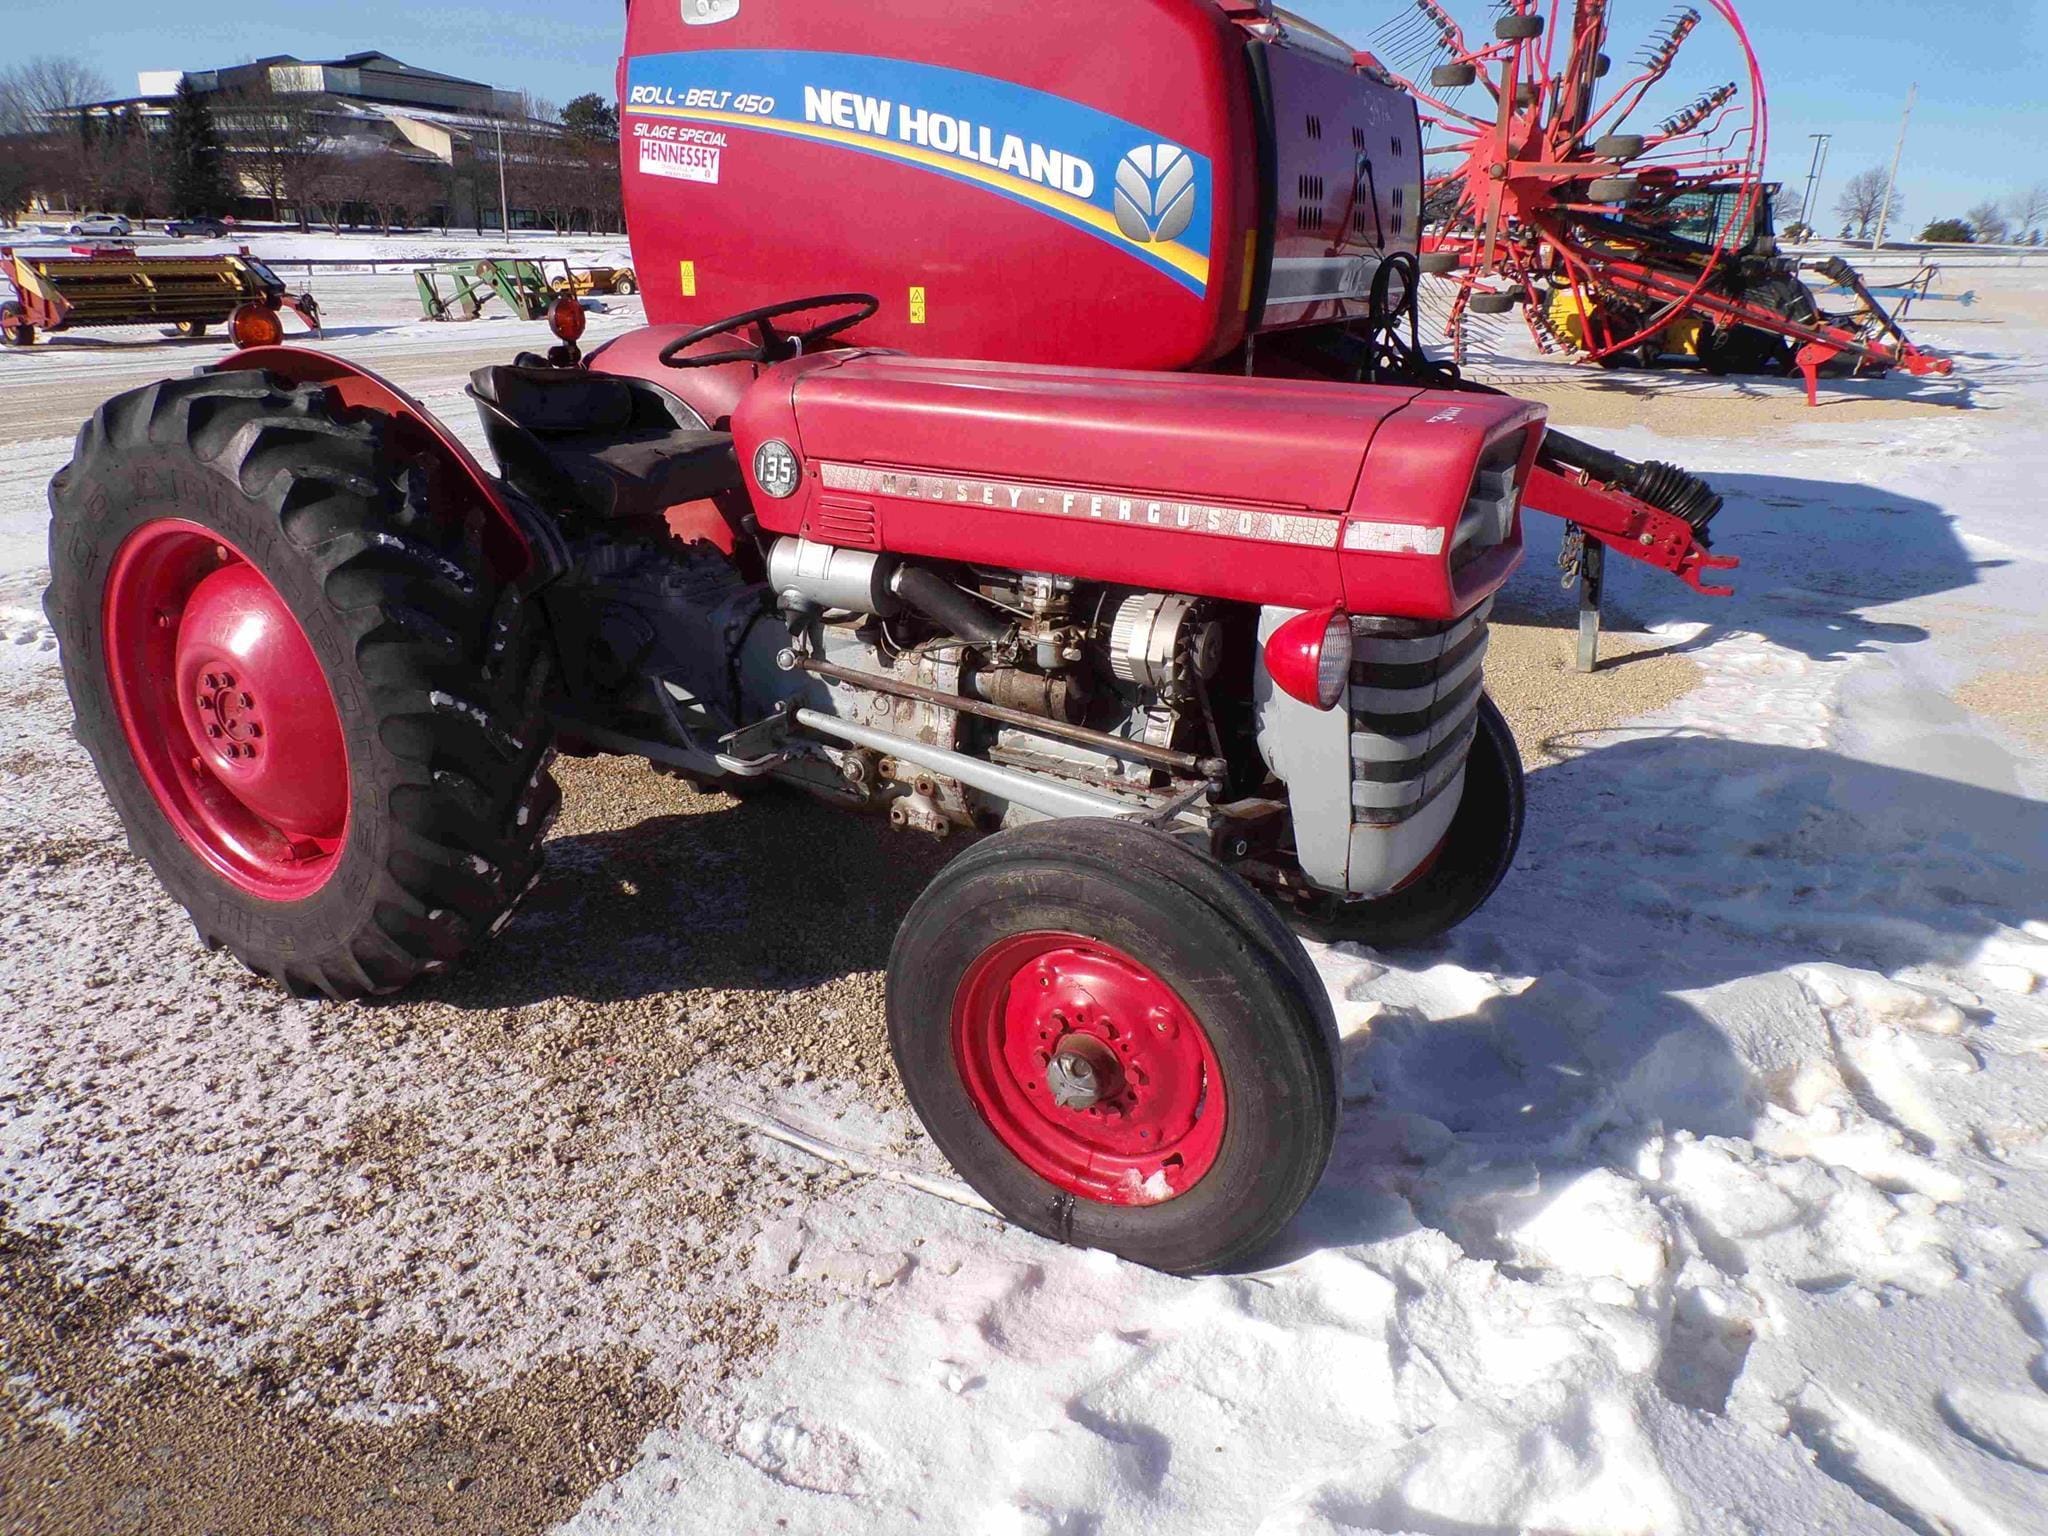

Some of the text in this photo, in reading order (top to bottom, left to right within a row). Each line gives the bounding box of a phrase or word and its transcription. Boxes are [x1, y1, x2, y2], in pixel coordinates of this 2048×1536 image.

[630, 86, 775, 114] ROLL-BELT 450
[633, 123, 728, 147] SILAGE SPECIAL
[804, 85, 1095, 199] NEW HOLLAND
[641, 140, 717, 169] HENNESSEY
[759, 454, 791, 483] 135
